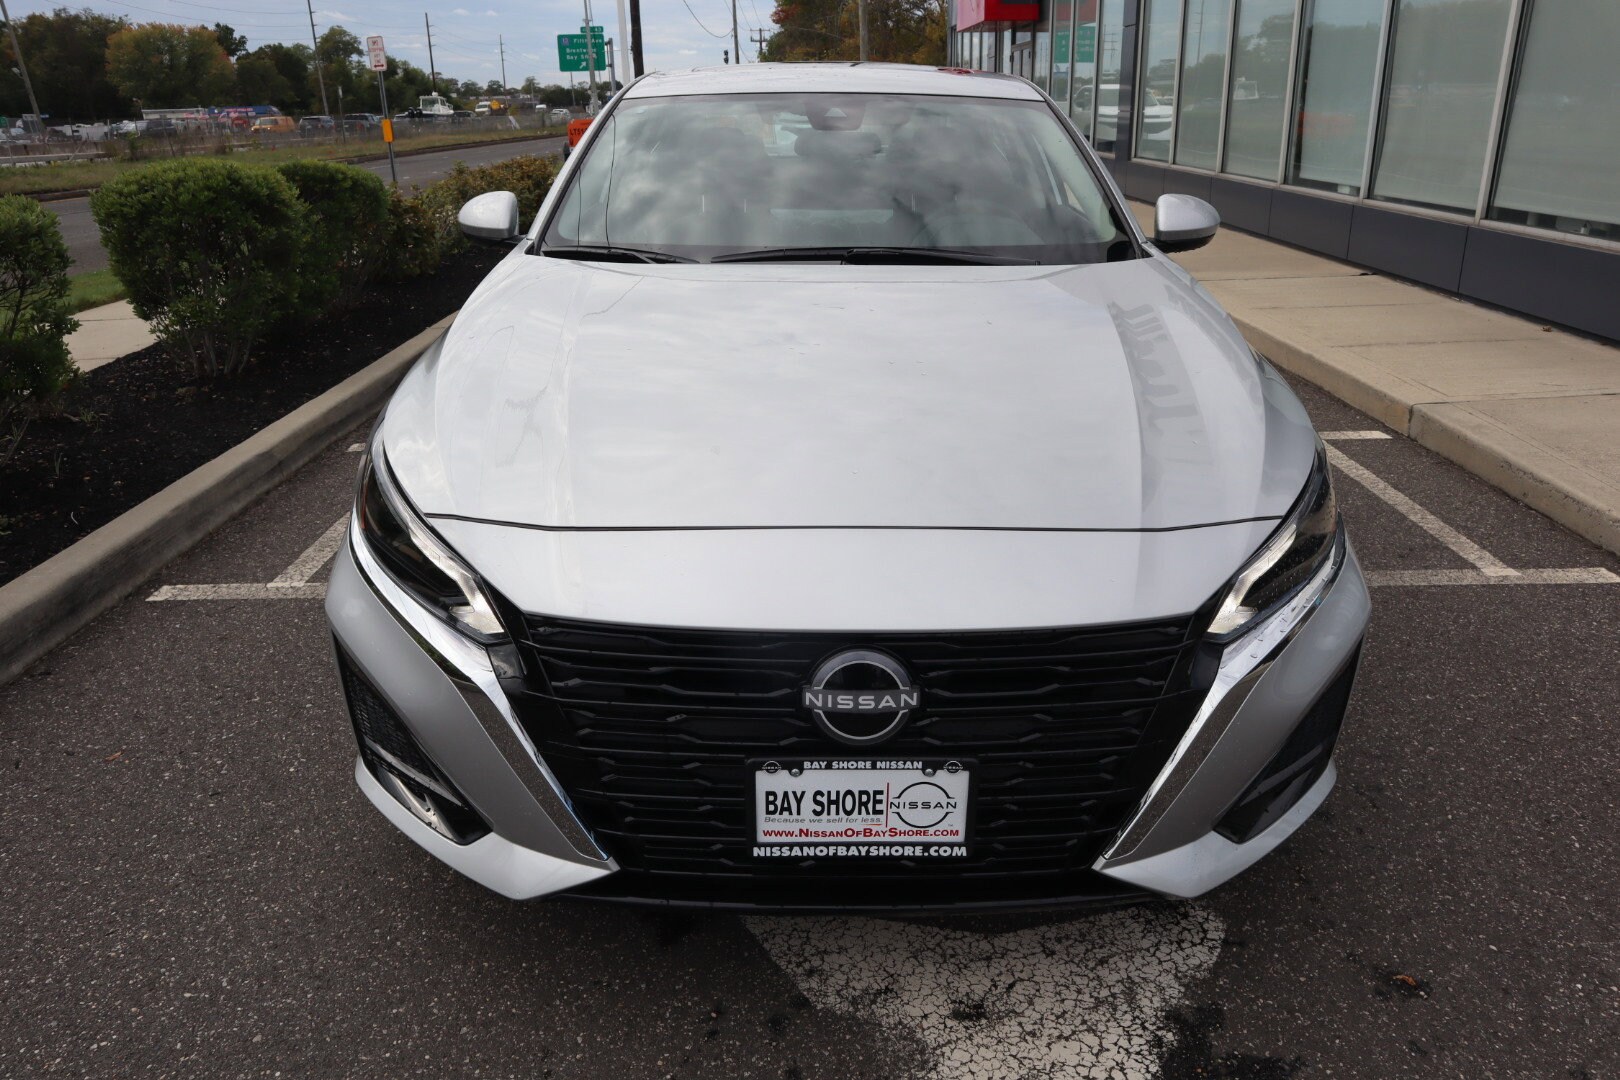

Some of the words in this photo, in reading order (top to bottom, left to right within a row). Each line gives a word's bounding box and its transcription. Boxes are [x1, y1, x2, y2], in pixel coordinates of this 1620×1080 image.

[805, 692, 918, 710] NISSAN
[803, 761, 828, 769] BAY
[832, 761, 872, 769] SHORE
[876, 761, 923, 769] NISSAN
[765, 791, 806, 816] BAY
[812, 789, 884, 817] SHORE
[890, 802, 957, 810] NISSAN
[753, 846, 967, 857] NISSANOFBAYSHORE.COM
